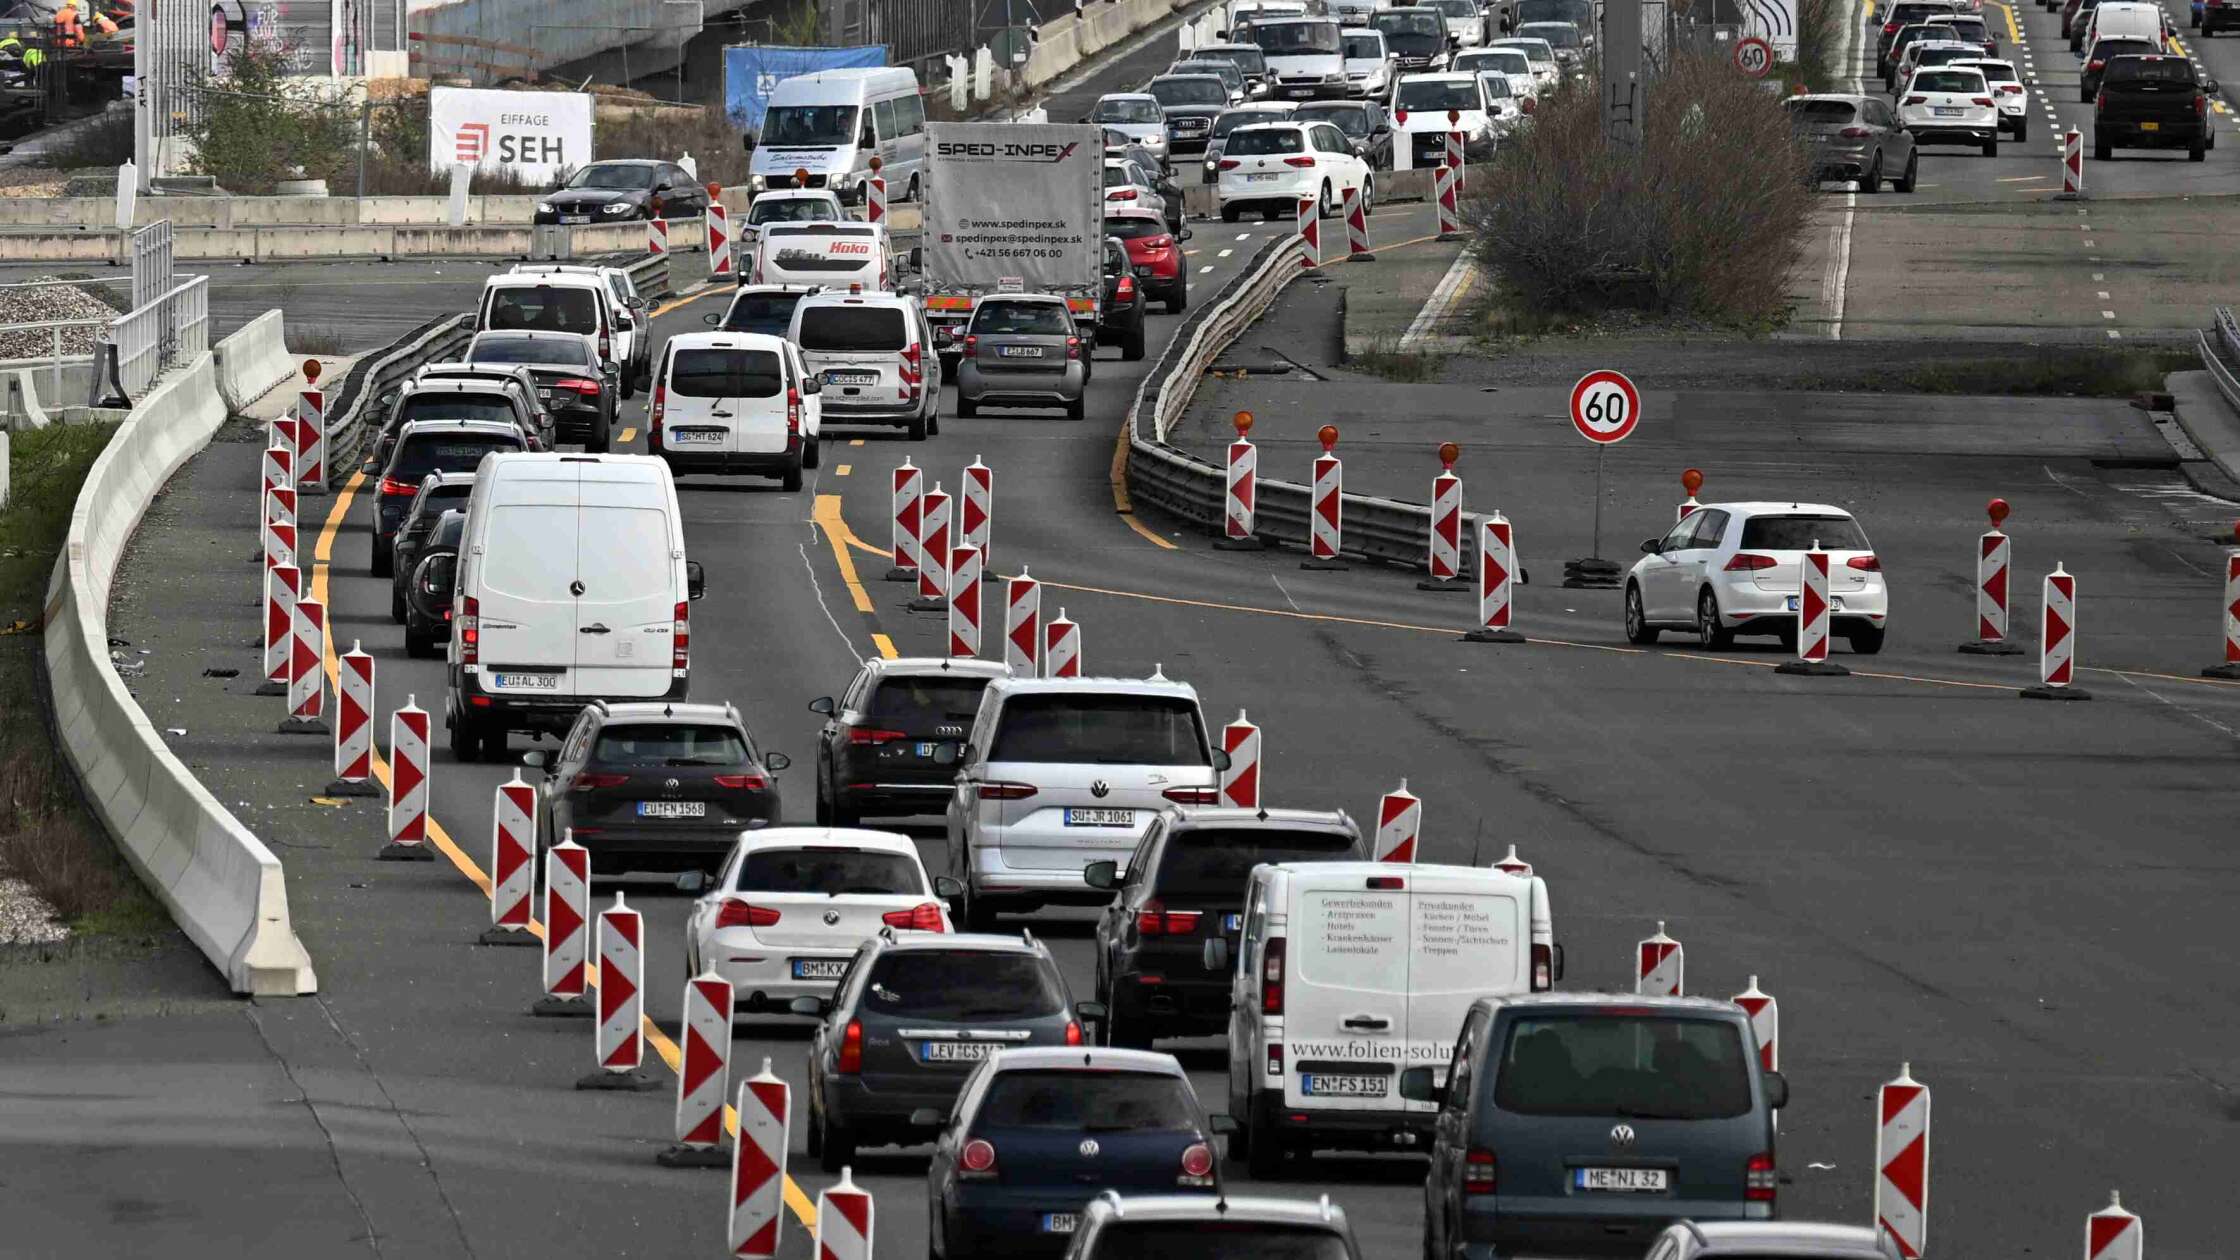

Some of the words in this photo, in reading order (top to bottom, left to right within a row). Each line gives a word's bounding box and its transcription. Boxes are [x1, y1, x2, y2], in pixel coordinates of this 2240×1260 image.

[1741, 48, 1763, 67] 60
[501, 113, 549, 126] EIFFAGE
[499, 134, 563, 164] SEH
[937, 141, 1080, 163] SPED-INPEX
[971, 219, 1066, 230] www.spedinpex.sk
[956, 234, 1083, 245] spedinpex@spedinpex.sk
[829, 241, 870, 254] Hako
[975, 249, 996, 258] +421
[999, 249, 1011, 258] 56
[1013, 249, 1031, 258] 667
[1033, 249, 1047, 258] 06
[1048, 249, 1063, 258] 00
[1585, 391, 1624, 424] 60
[682, 432, 692, 441] SG
[695, 432, 707, 441] HT
[708, 432, 723, 441] 624
[502, 674, 515, 687] EU
[521, 674, 535, 687] AL
[537, 675, 557, 687] 300
[644, 802, 657, 815] EU
[663, 802, 677, 815] FN
[679, 802, 705, 815] 1568
[1071, 809, 1085, 822] SU
[1093, 809, 1105, 822] JR
[1108, 809, 1132, 823] 1061
[1321, 898, 1393, 909] Gewerbekunden
[1327, 922, 1355, 931] Hotels
[803, 962, 819, 975] BM
[827, 963, 844, 975] KX
[930, 1044, 955, 1058] LEV
[962, 1045, 980, 1058] CS
[1312, 1077, 1332, 1090] EN
[1339, 1078, 1357, 1091] FS
[1360, 1079, 1385, 1092] 151
[1589, 1171, 1608, 1186] ME
[1618, 1171, 1636, 1186] NI
[1641, 1172, 1659, 1187] 32
[1053, 1214, 1073, 1230] BM
